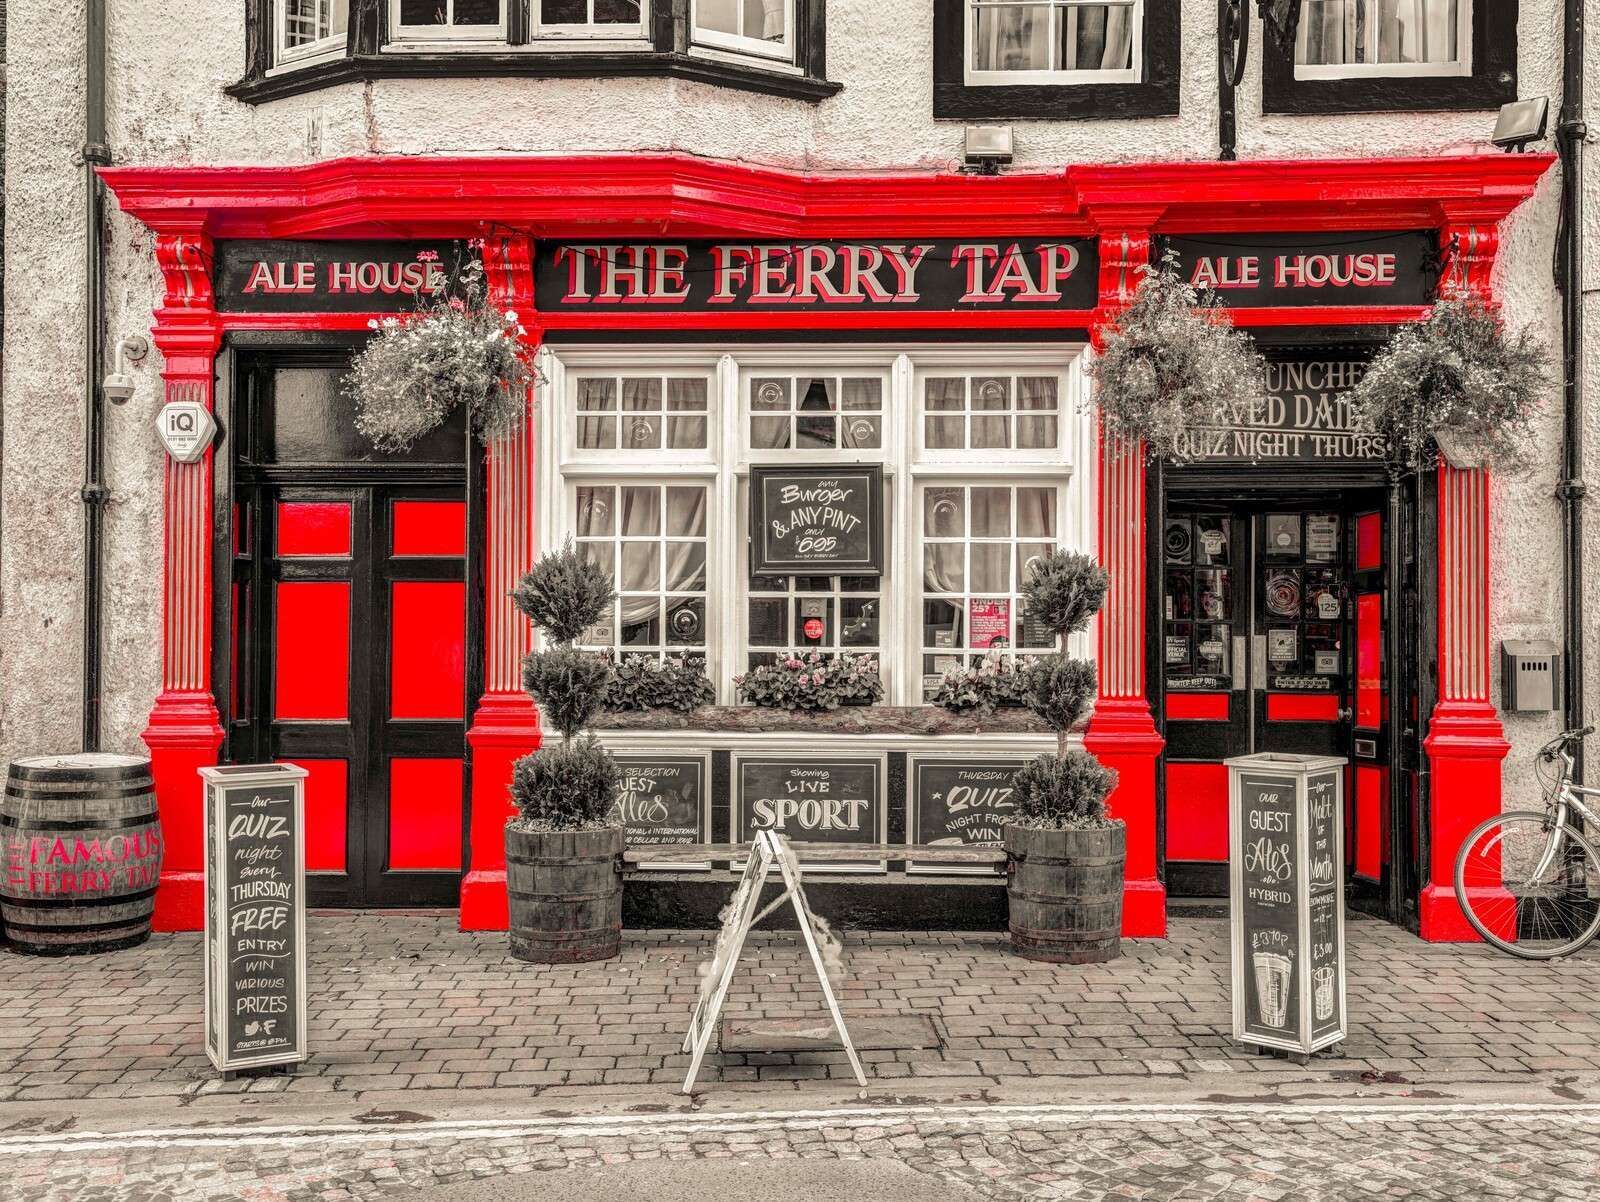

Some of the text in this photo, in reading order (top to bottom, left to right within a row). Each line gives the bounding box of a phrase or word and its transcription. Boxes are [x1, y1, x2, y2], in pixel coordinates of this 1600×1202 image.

[242, 262, 444, 294] ALE HOUSE
[553, 243, 1080, 304] THE FERRY TAP
[1190, 253, 1396, 289] ALE HOUSE
[1265, 361, 1368, 392] UNCHE
[170, 412, 194, 432] iQ
[1294, 393, 1361, 430] DAIL
[1173, 431, 1387, 460] QUIZ NIGHT THURS
[781, 484, 853, 506] Burger
[772, 506, 861, 538] & ANY PINT
[625, 767, 680, 777] SELECTION
[958, 771, 1010, 780] THURSDAY
[614, 777, 657, 793] UEST
[785, 780, 829, 794] LIVE
[250, 795, 271, 808] Our
[946, 785, 1014, 814] QUIZ
[750, 799, 869, 831] SPORT
[945, 813, 982, 832] NIGHT
[1249, 810, 1292, 833] GUEST
[228, 813, 290, 841] QUIZ
[966, 828, 1001, 840] WIN
[29, 828, 160, 864] FAMOUS
[234, 845, 283, 864] night
[1245, 836, 1292, 880] Ales
[28, 869, 115, 893] FERRY
[231, 881, 292, 902] THURSDAY
[1248, 887, 1291, 904] HYBRID
[231, 906, 289, 936] FREE
[237, 939, 287, 951] ENTRY
[246, 959, 275, 972] WIN
[235, 978, 285, 990] VARIOUS
[236, 996, 288, 1015] PRIZES
